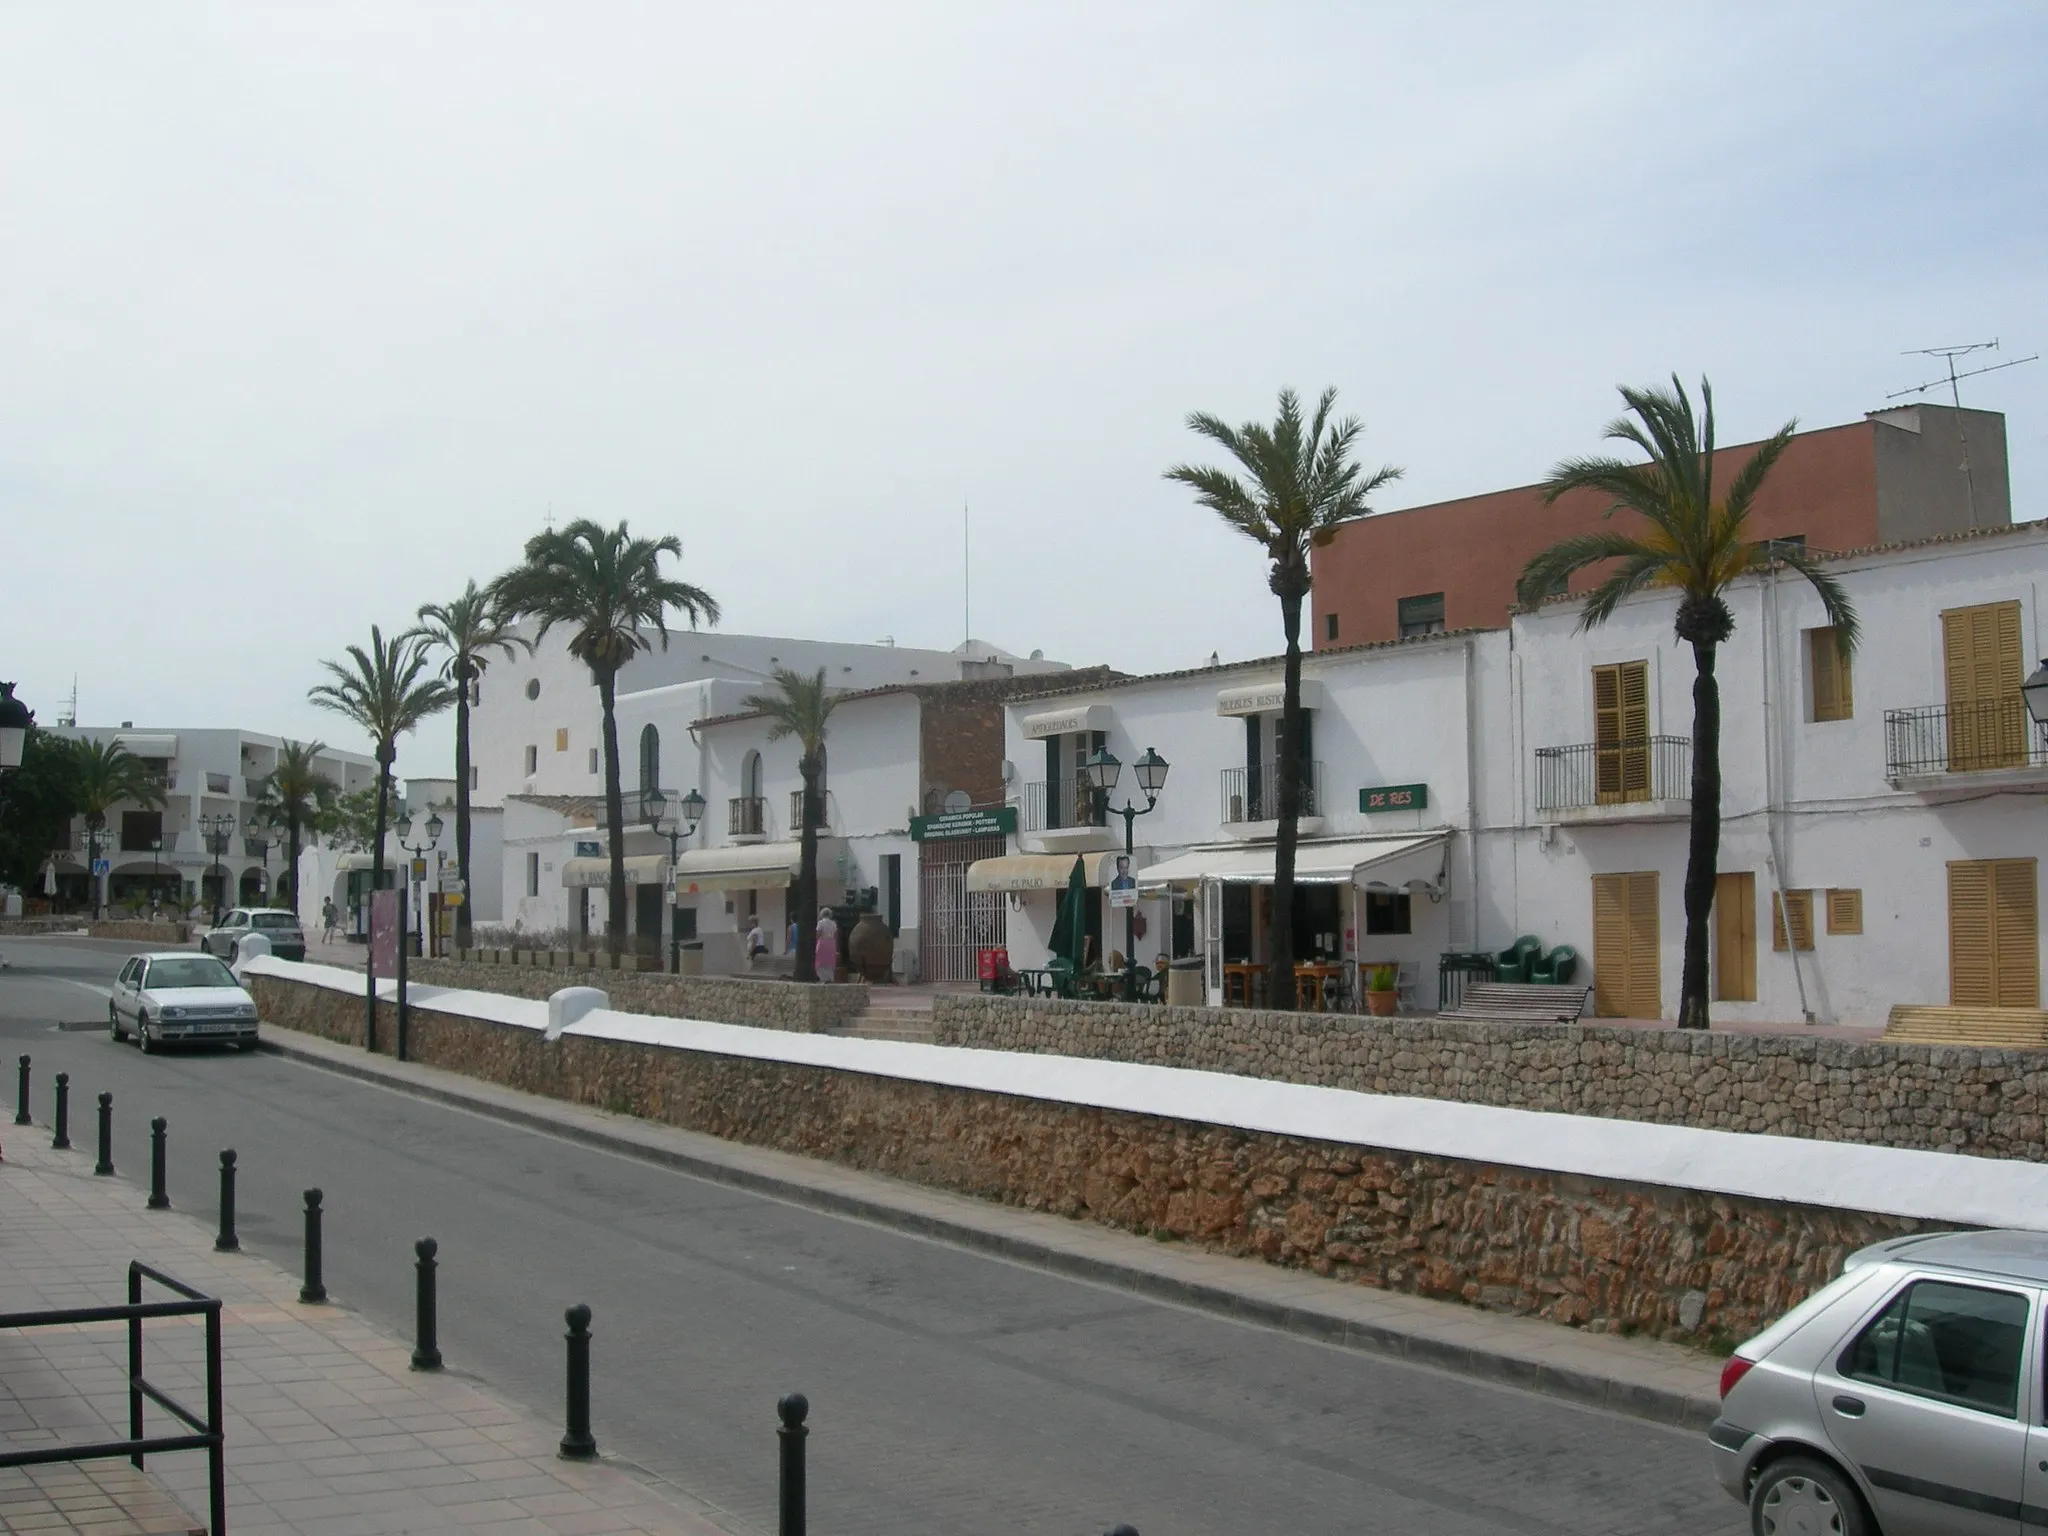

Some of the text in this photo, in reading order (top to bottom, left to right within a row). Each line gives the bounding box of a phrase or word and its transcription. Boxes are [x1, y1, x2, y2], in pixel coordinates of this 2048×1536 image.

[1220, 697, 1252, 711] MUEBLES
[1370, 791, 1412, 806] DE RES
[963, 812, 984, 820] POPULAR
[975, 818, 997, 826] POTTERY
[1011, 879, 1019, 889] EL
